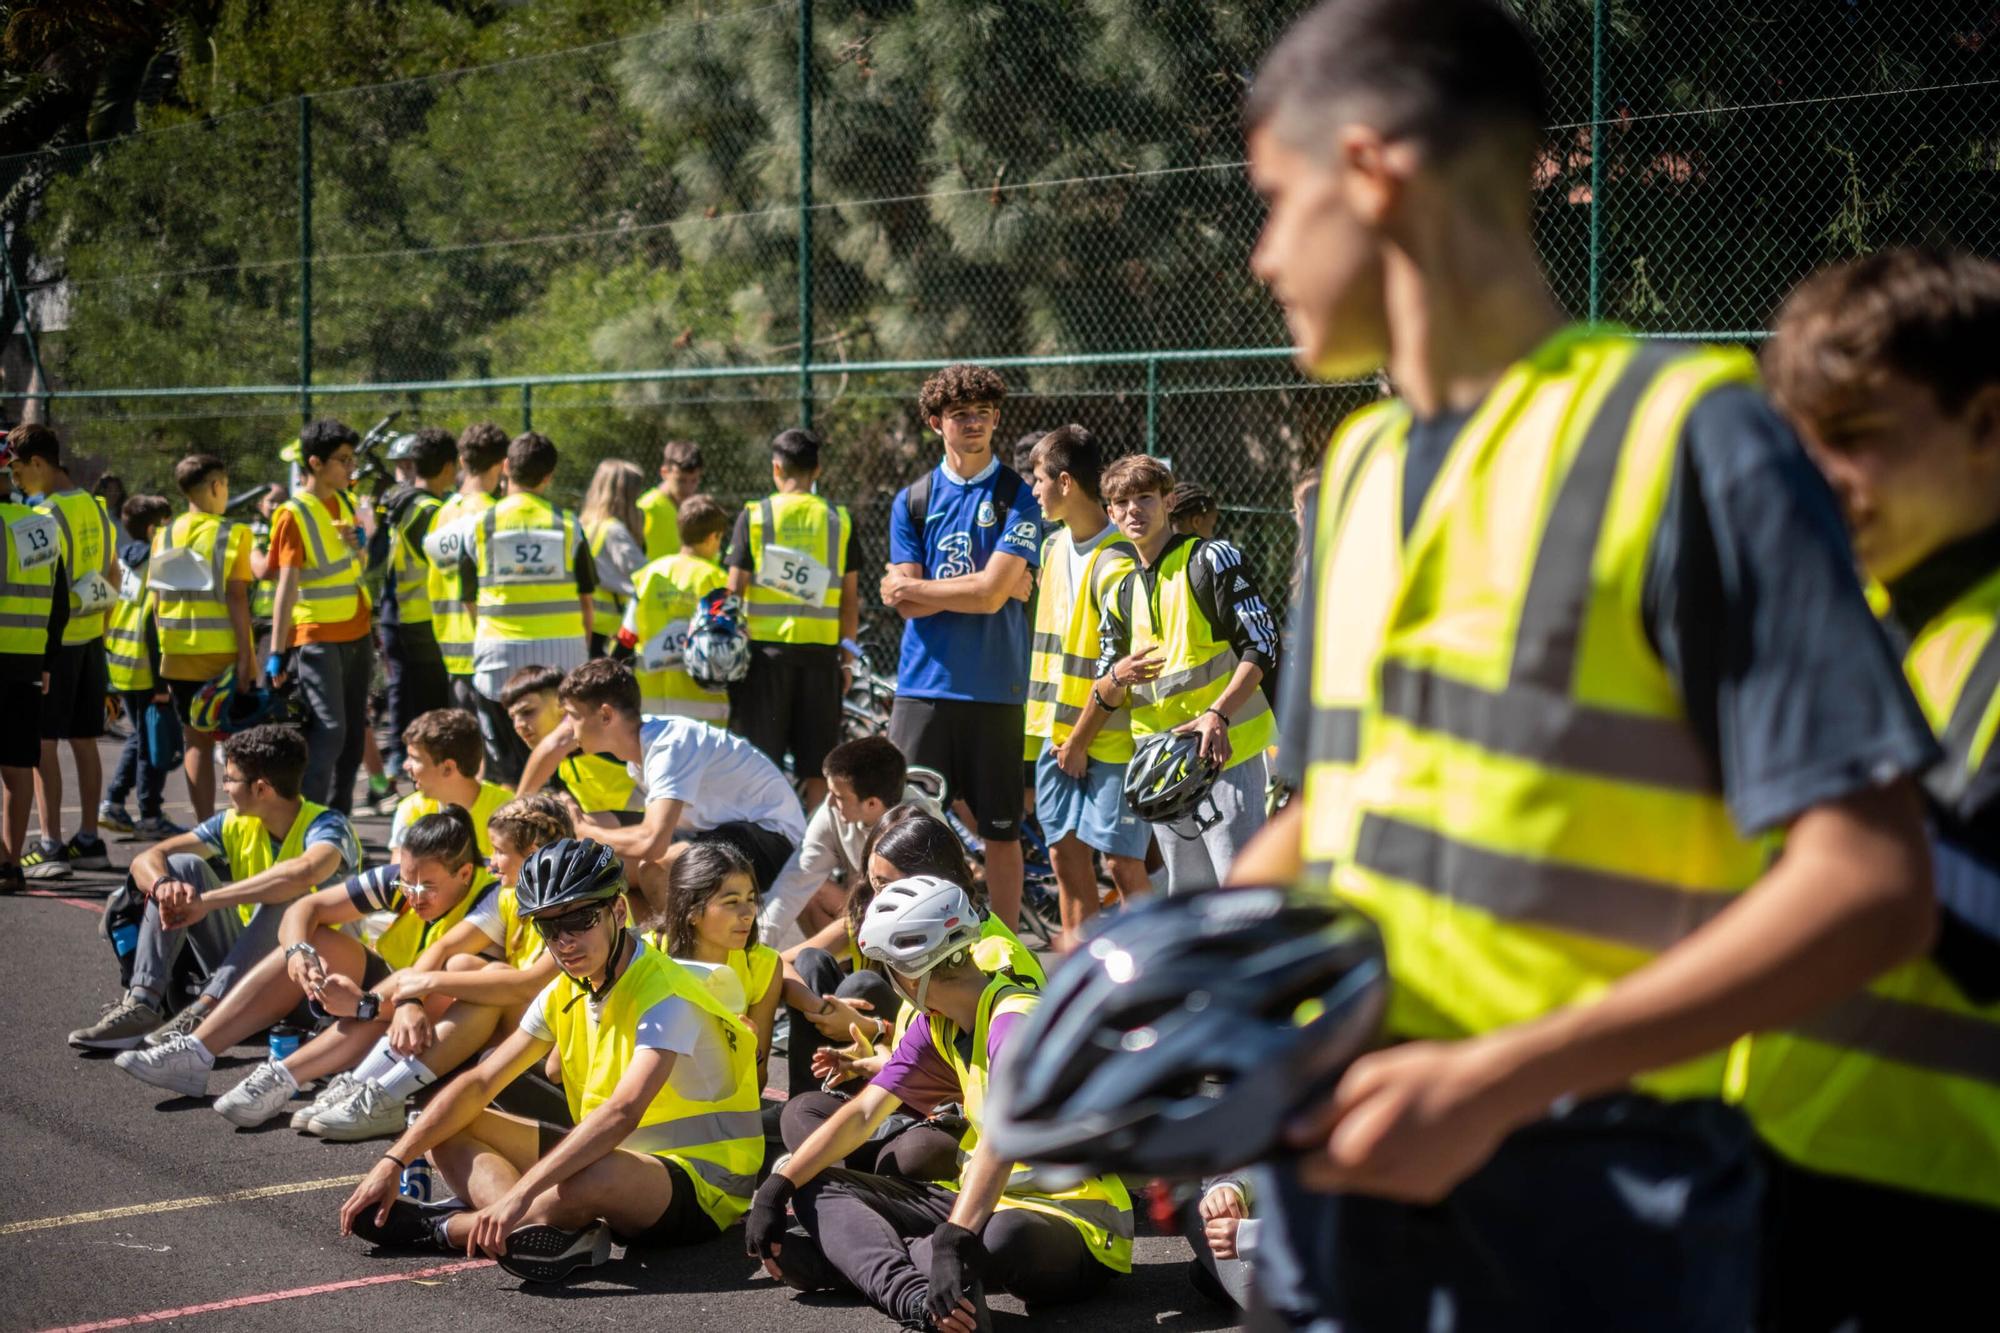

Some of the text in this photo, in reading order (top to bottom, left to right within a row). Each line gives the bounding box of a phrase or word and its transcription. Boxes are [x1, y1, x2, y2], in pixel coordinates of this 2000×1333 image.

[28, 529, 48, 550] 13
[440, 533, 459, 554] 60
[515, 543, 543, 563] 52
[780, 560, 810, 585] 56
[90, 583, 108, 602] 34
